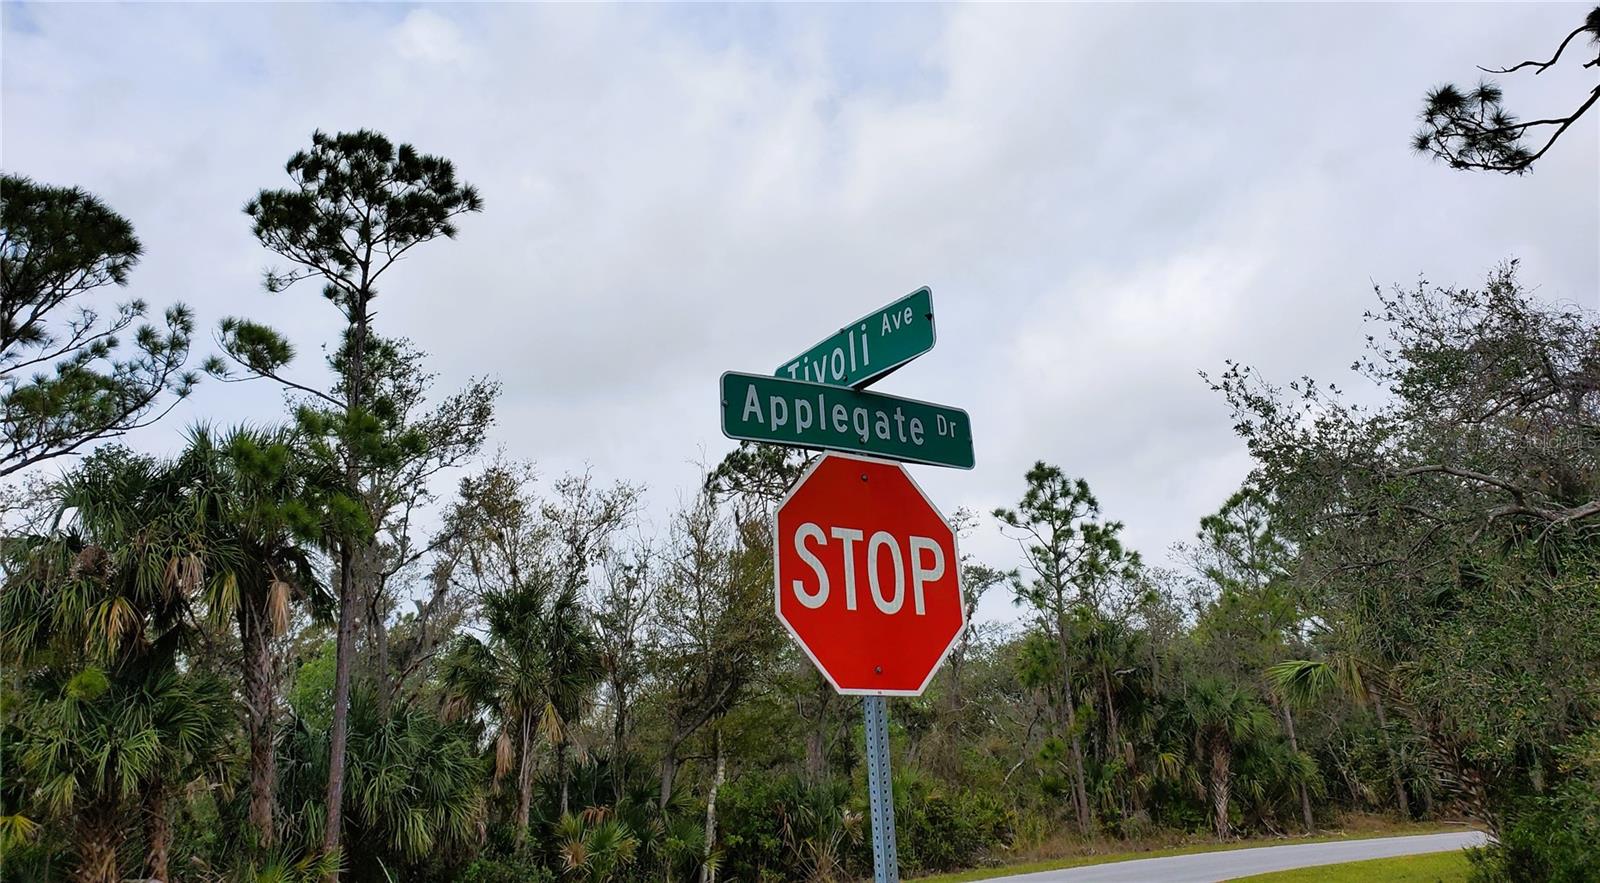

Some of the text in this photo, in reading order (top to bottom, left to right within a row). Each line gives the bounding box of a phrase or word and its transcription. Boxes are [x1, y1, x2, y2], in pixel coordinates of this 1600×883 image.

[788, 306, 913, 383] Tivoli Ave
[741, 384, 957, 445] Applegate Dr
[792, 522, 945, 616] STOP
